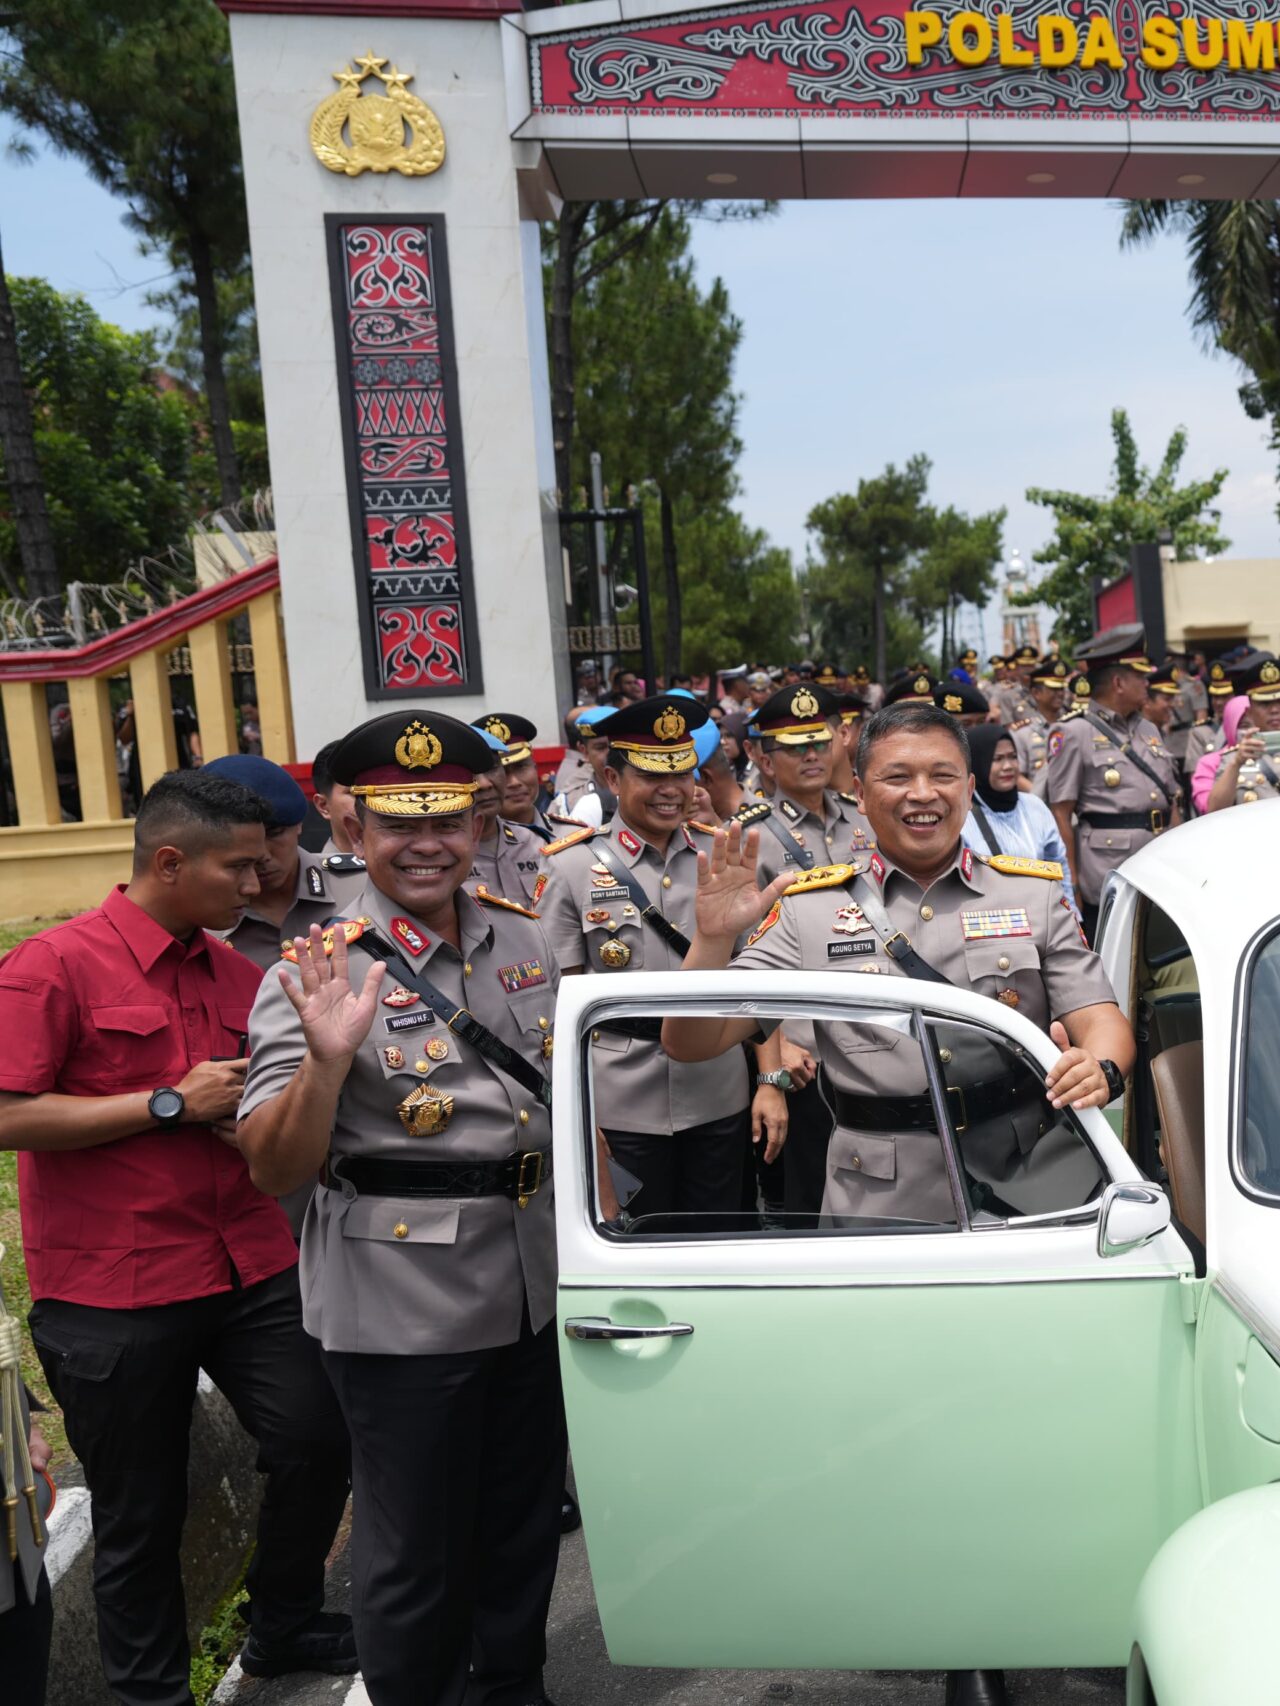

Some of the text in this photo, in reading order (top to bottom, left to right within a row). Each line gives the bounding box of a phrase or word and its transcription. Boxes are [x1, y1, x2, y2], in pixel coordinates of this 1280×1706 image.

[904, 10, 1124, 69] POLDA
[831, 942, 872, 953] AGUNG SETYA
[391, 1016, 417, 1028] WHISNU
